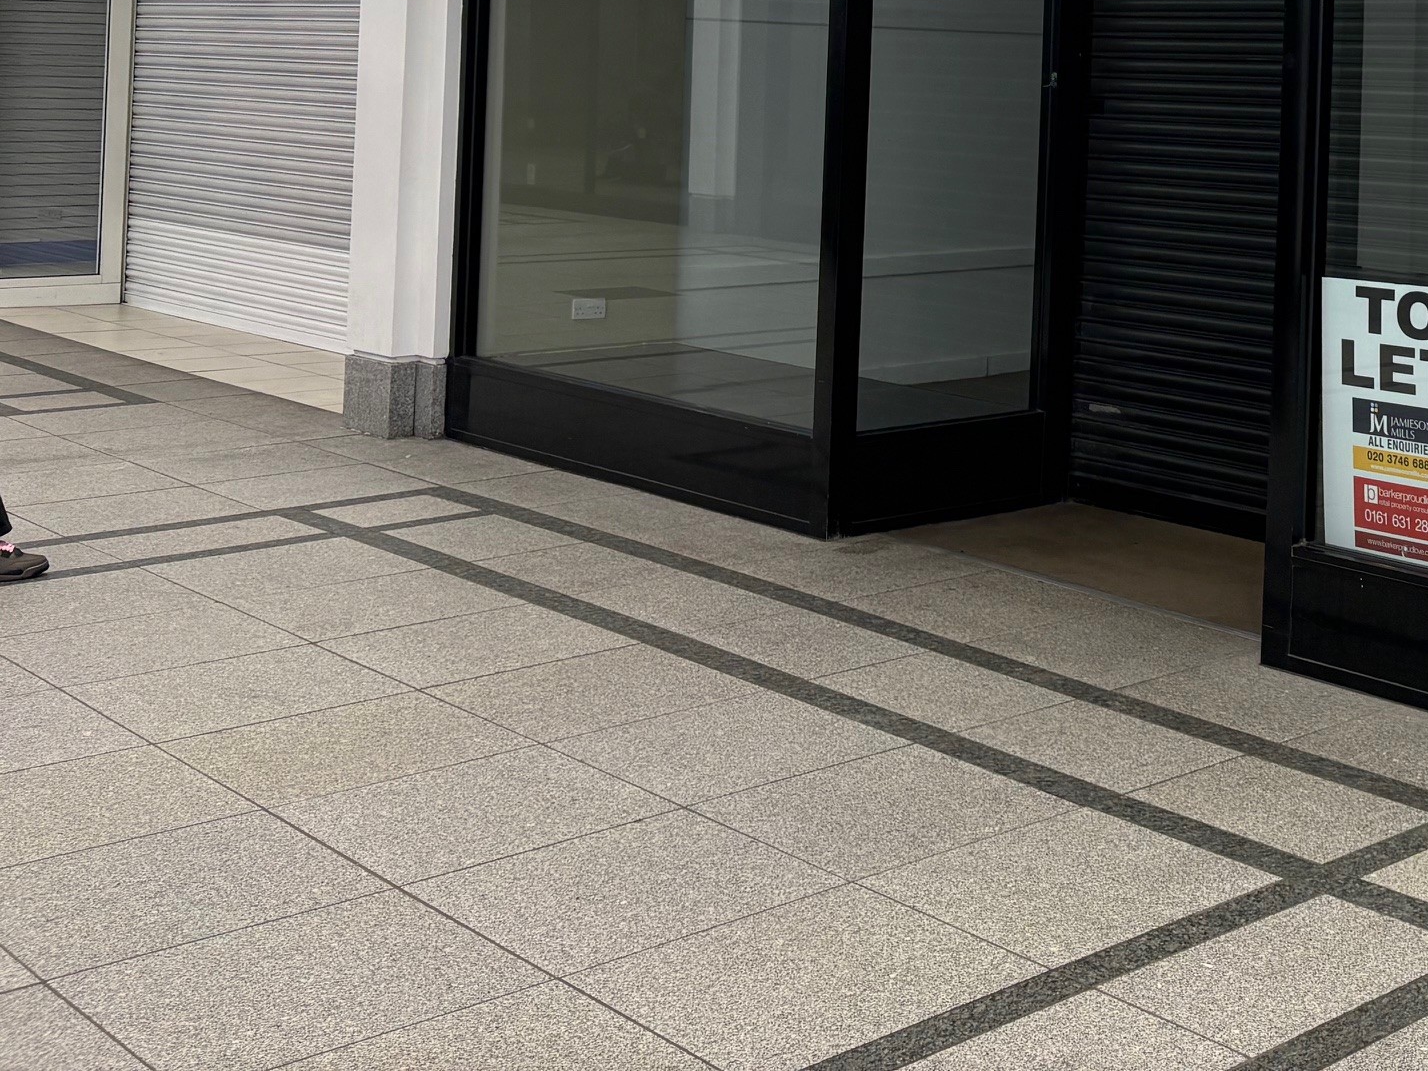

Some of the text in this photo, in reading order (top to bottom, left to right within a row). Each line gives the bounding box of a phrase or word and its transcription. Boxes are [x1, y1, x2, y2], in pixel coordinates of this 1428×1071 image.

[1390, 428, 1416, 440] MILLS
[1368, 436, 1385, 448] ALL
[1367, 450, 1384, 462] 020
[1387, 454, 1409, 467] 3746
[1364, 508, 1388, 525] 0161
[1392, 514, 1410, 530] 631
